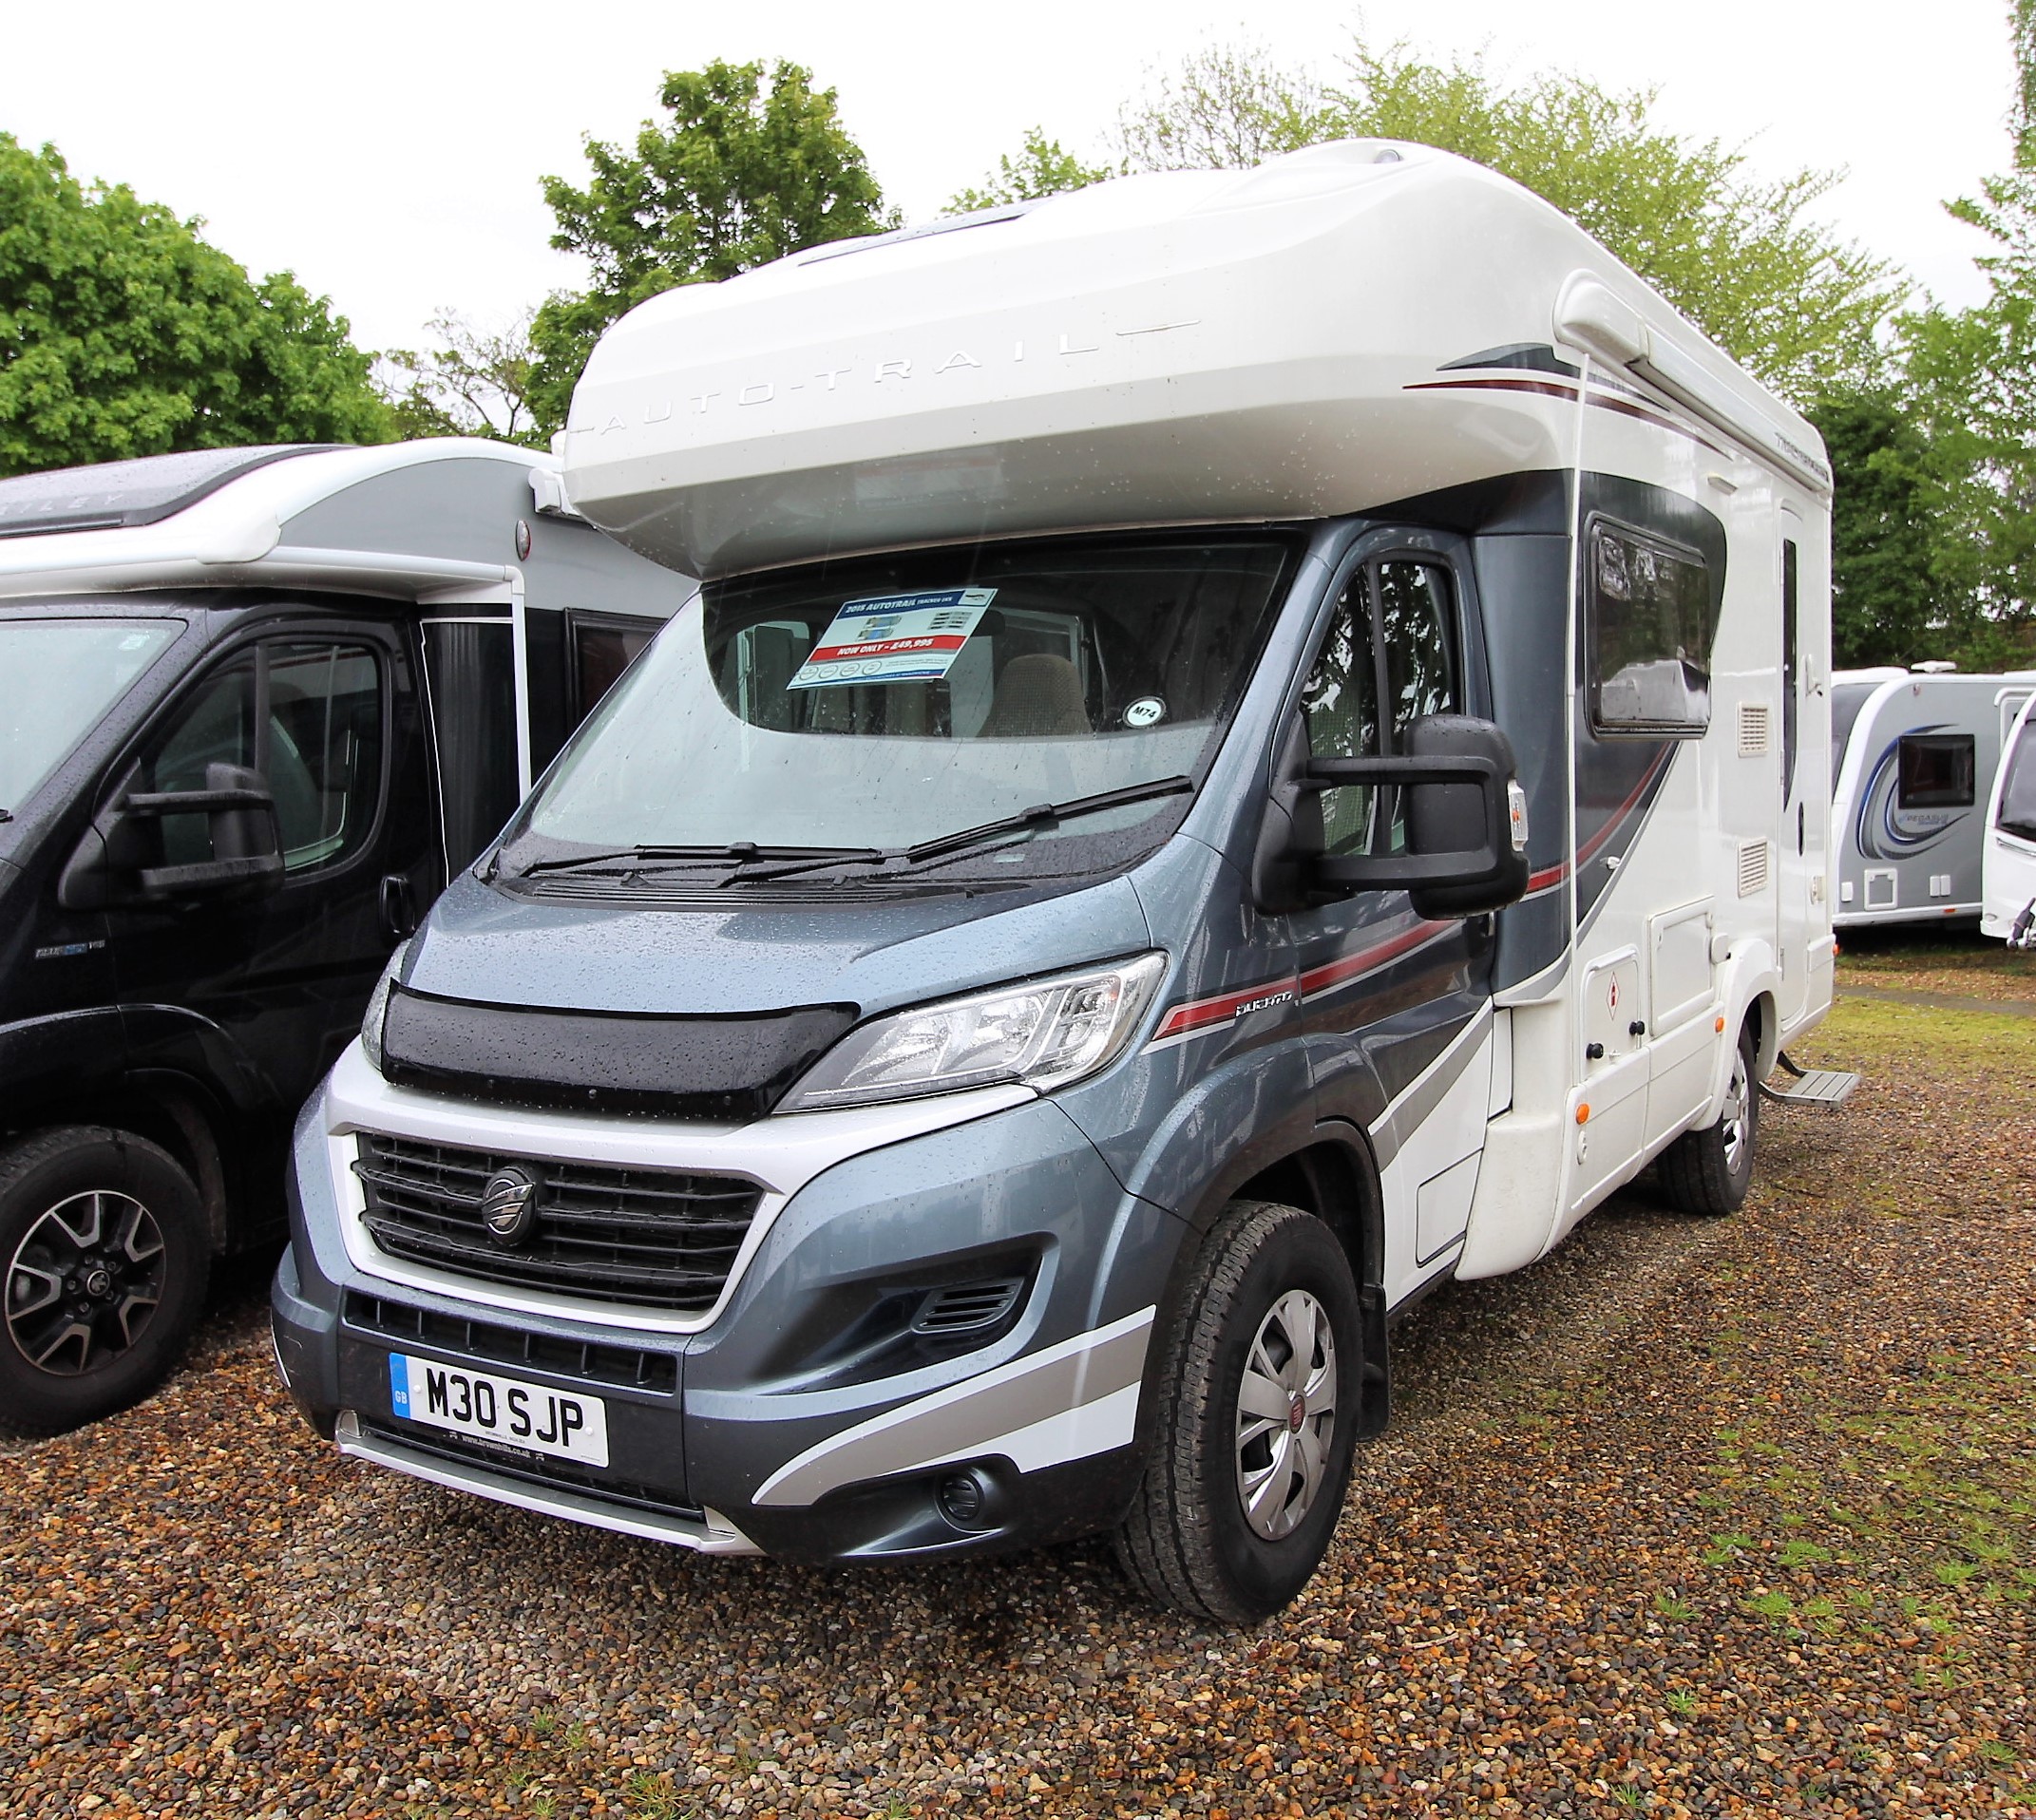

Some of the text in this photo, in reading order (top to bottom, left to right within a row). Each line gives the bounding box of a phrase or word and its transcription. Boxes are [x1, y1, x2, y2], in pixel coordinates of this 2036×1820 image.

[599, 333, 1099, 435] AUTO-TRAIL
[846, 603, 866, 614] 2015
[866, 599, 917, 612] AUTOTRAIL
[837, 647, 860, 655] NOW
[860, 644, 884, 654] ONLY
[889, 638, 934, 651] £49,995
[394, 1389, 408, 1405] GB
[426, 1367, 583, 1447] M30 SJP
